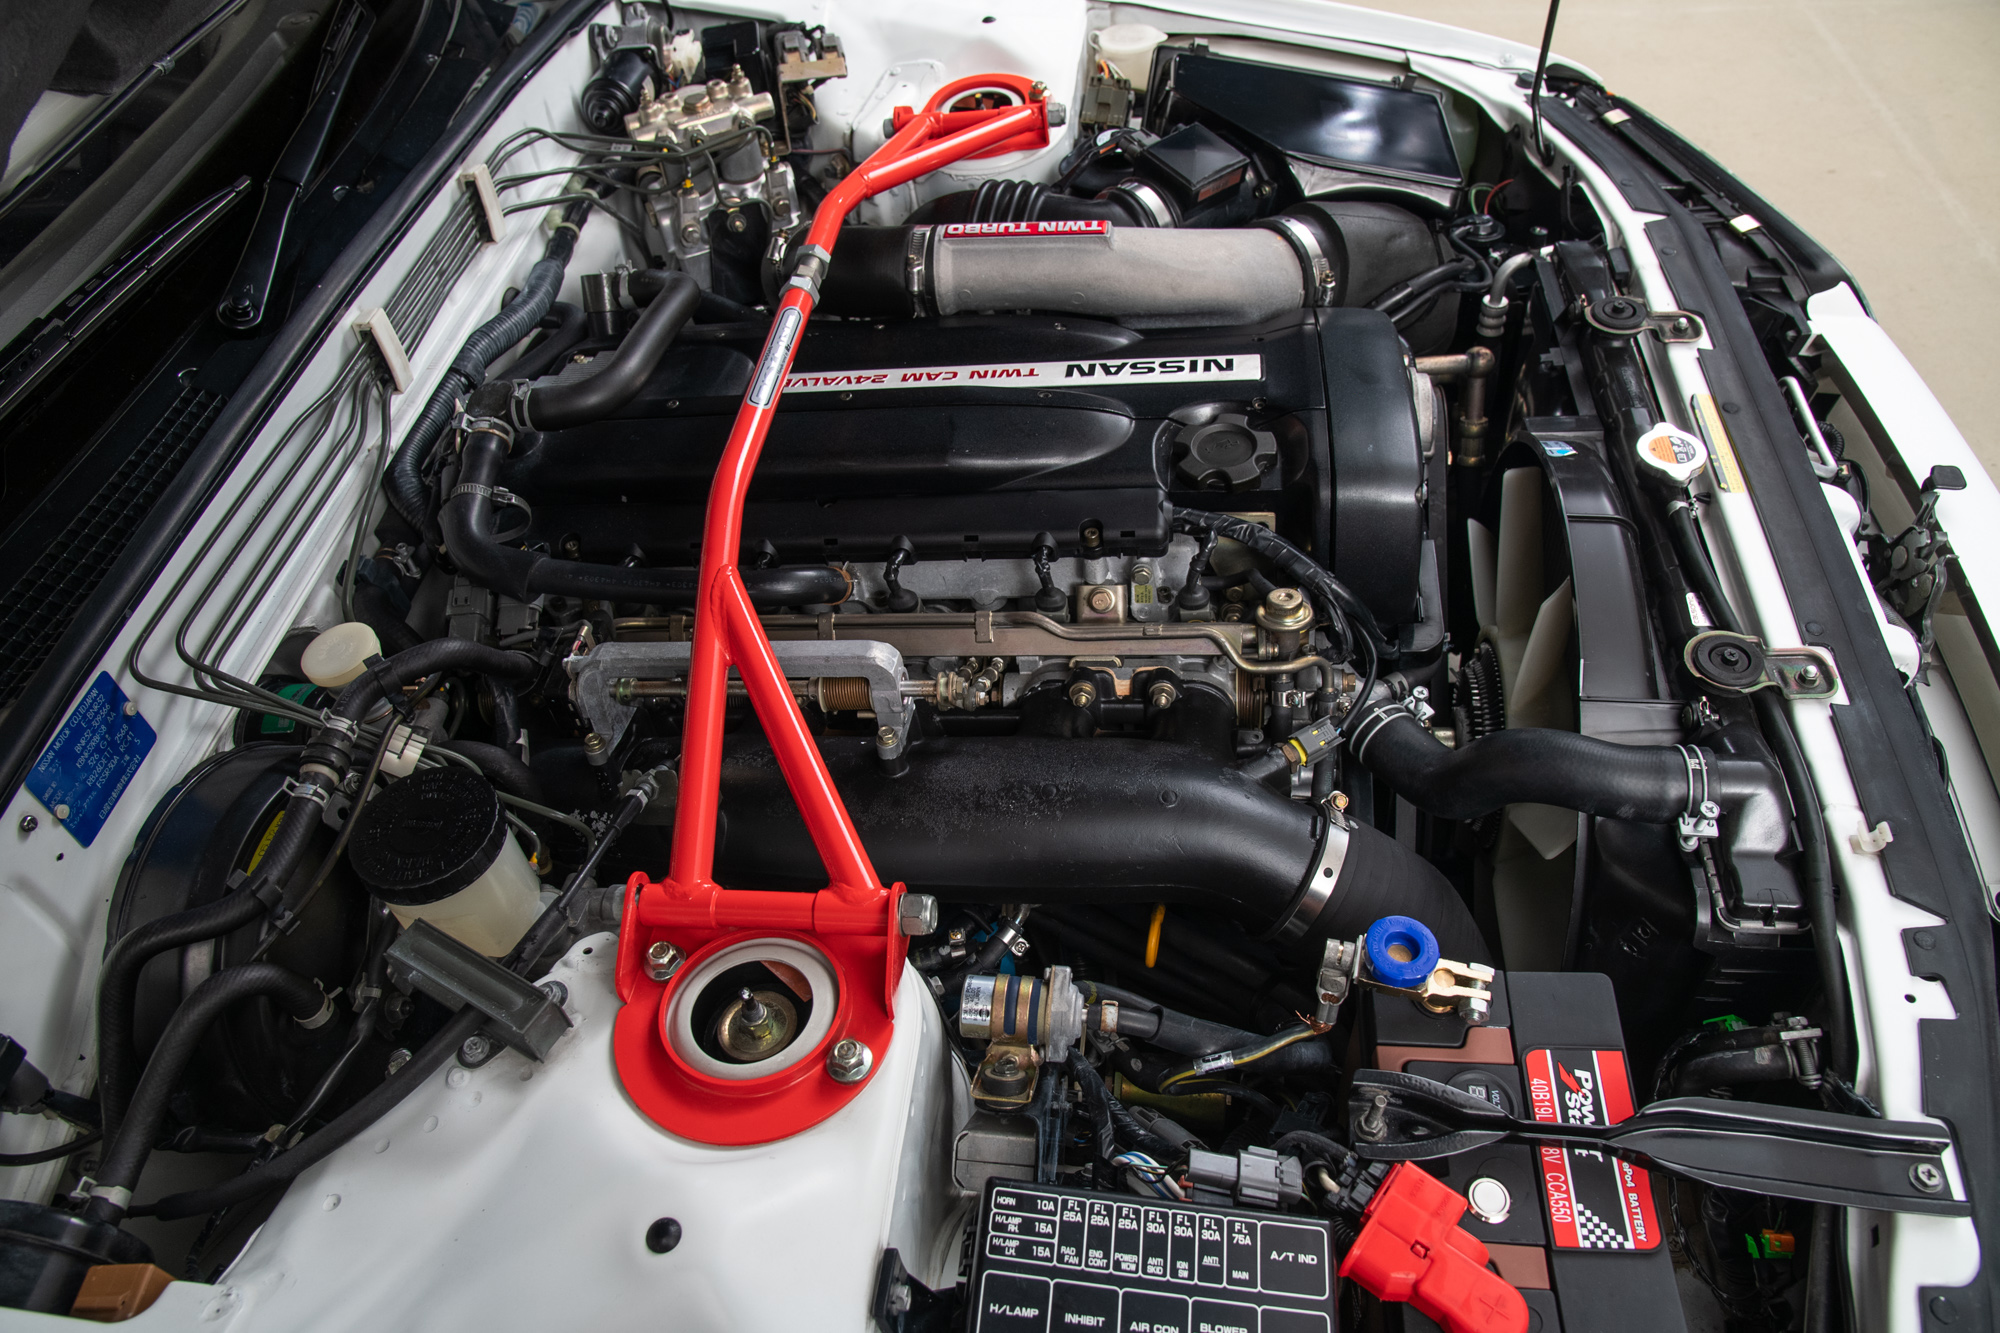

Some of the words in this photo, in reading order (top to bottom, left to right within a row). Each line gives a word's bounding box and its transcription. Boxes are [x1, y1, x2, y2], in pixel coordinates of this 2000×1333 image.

[947, 223, 1030, 234] TURBO
[1038, 221, 1102, 232] TWIN
[969, 367, 1040, 380] TWIN
[1064, 358, 1234, 379] NISSAN
[900, 371, 958, 383] CAM
[39, 751, 54, 773] NISSAN
[54, 728, 70, 751] MOTOR
[86, 747, 113, 786] RB26DETT
[114, 723, 128, 743] 2568
[1530, 1078, 1554, 1121] 40B19L
[1546, 1172, 1572, 1223] CCA550
[997, 1196, 1016, 1206] HORN
[1036, 1199, 1055, 1212] 10A
[1068, 1200, 1080, 1211] FL
[1093, 1203, 1107, 1214] FL
[1063, 1211, 1082, 1223] 25A
[1122, 1207, 1135, 1218] FL
[1627, 1192, 1648, 1242] BATTERY
[995, 1214, 1022, 1225] H/LAMP
[1034, 1221, 1052, 1234] 15A
[1090, 1215, 1110, 1227] 25A
[1118, 1218, 1138, 1230] 25A
[1146, 1222, 1166, 1234] 30A
[1174, 1226, 1193, 1238] 30A
[1201, 1229, 1221, 1241] 30A
[1232, 1233, 1252, 1246] 75A
[992, 1236, 1019, 1248] H/LAMP
[1032, 1246, 1051, 1258] 15A
[1060, 1246, 1076, 1255] RAD
[1064, 1255, 1079, 1265] FAN
[1088, 1249, 1103, 1259] ENG
[1114, 1252, 1138, 1264] POWER
[1270, 1250, 1294, 1263] A/T
[1298, 1254, 1317, 1265] IND
[1088, 1258, 1107, 1268] CONT
[1120, 1262, 1137, 1272] WDW
[1147, 1257, 1163, 1267] ANTI
[1177, 1261, 1188, 1269] IGN
[1202, 1256, 1219, 1266] ANTI
[1147, 1265, 1163, 1275] SKID
[1178, 1268, 1188, 1278] SW
[1232, 1270, 1249, 1280] MAIN
[990, 1303, 1039, 1318] H/LAMP
[1065, 1312, 1105, 1328] INHIBIT
[1130, 1321, 1150, 1332] AIR
[1153, 1324, 1179, 1333] CON
[1200, 1322, 1247, 1333] BLOWER
